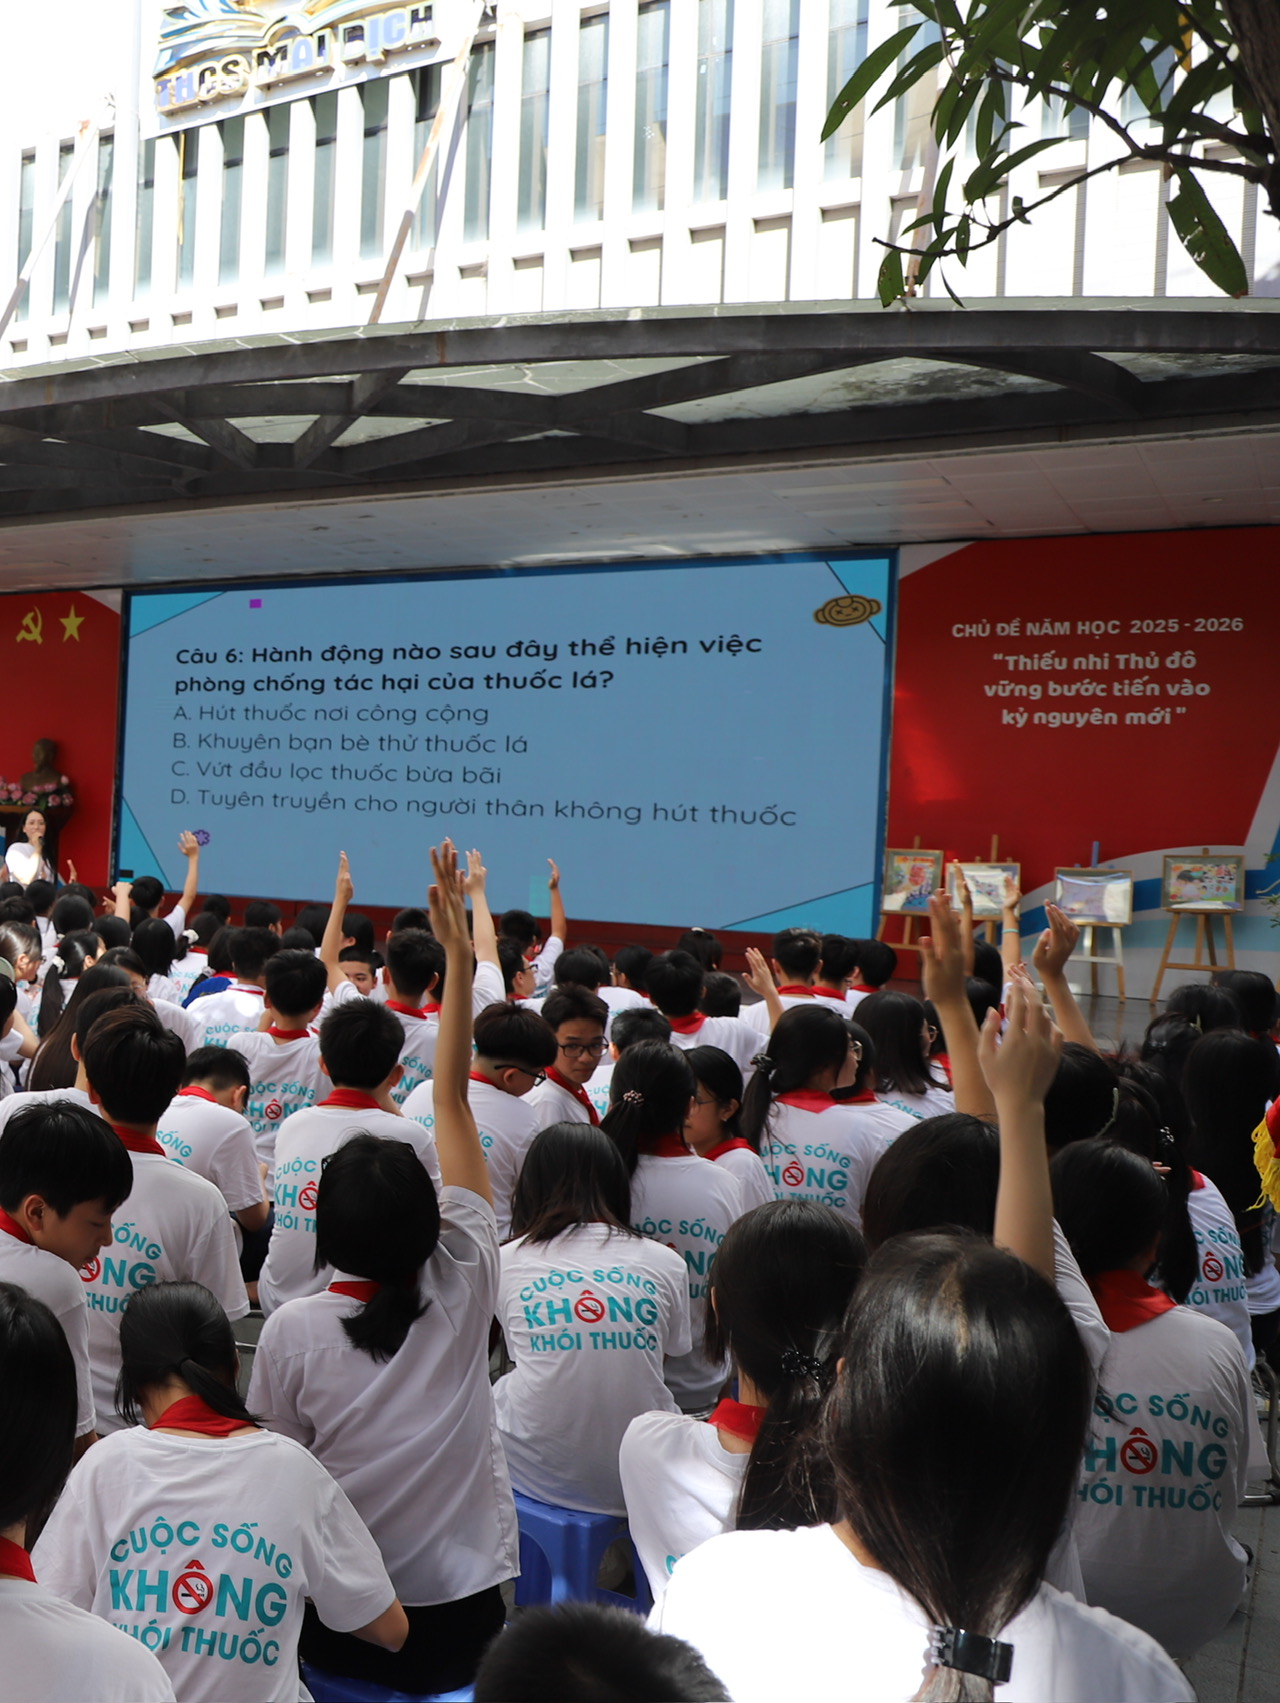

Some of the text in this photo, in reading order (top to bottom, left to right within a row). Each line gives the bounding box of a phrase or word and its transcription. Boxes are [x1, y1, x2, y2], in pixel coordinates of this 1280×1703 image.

[157, 56, 247, 108] THCS
[256, 30, 332, 82] MAI
[951, 618, 991, 638] CHỦ
[995, 617, 1021, 637] ĐỀ
[1026, 618, 1071, 636] NĂM
[1076, 619, 1121, 640] HỌC
[175, 633, 762, 665] Câu 6: Hành động nào sau đây thể hiện việc
[1072, 652, 1110, 671] nhi
[1114, 650, 1160, 670] Thủ
[1164, 649, 1197, 669] đô
[174, 668, 614, 696] phòng chống tác hại của thuốc lá?
[983, 675, 1211, 701] vững bước tiến vào
[173, 702, 489, 726] A. Hút thuốc nơi công cộng
[1001, 706, 1029, 729] kỷ
[1032, 707, 1118, 729] nguyên
[172, 732, 528, 754] B. Khuyên bạn bè thử thuốc lá
[170, 760, 501, 785] C. Vứt đầu lọc thuốc bừa bãi
[170, 788, 797, 827] D. Tuyên truyền cho người thân không hút thuốc
[281, 1080, 316, 1100] SỐNG
[761, 1141, 852, 1169] UỘC SỐNG
[764, 1161, 849, 1191] HÔNG
[276, 1211, 299, 1230] HÓI
[111, 1222, 162, 1260] ỐNG
[520, 1270, 584, 1301] CUỘC
[592, 1266, 656, 1295] SỐNG
[523, 1289, 658, 1330] KHÔNG
[530, 1326, 657, 1352] KHÓI THUỐC
[1148, 1392, 1230, 1439] SỐNG
[1084, 1426, 1228, 1480] HÔNG
[1077, 1477, 1124, 1507] HÓI
[110, 1515, 293, 1579] CUỘC SỐNG
[109, 1559, 288, 1628] KHÔNG
[181, 1627, 280, 1666] THUỐC
